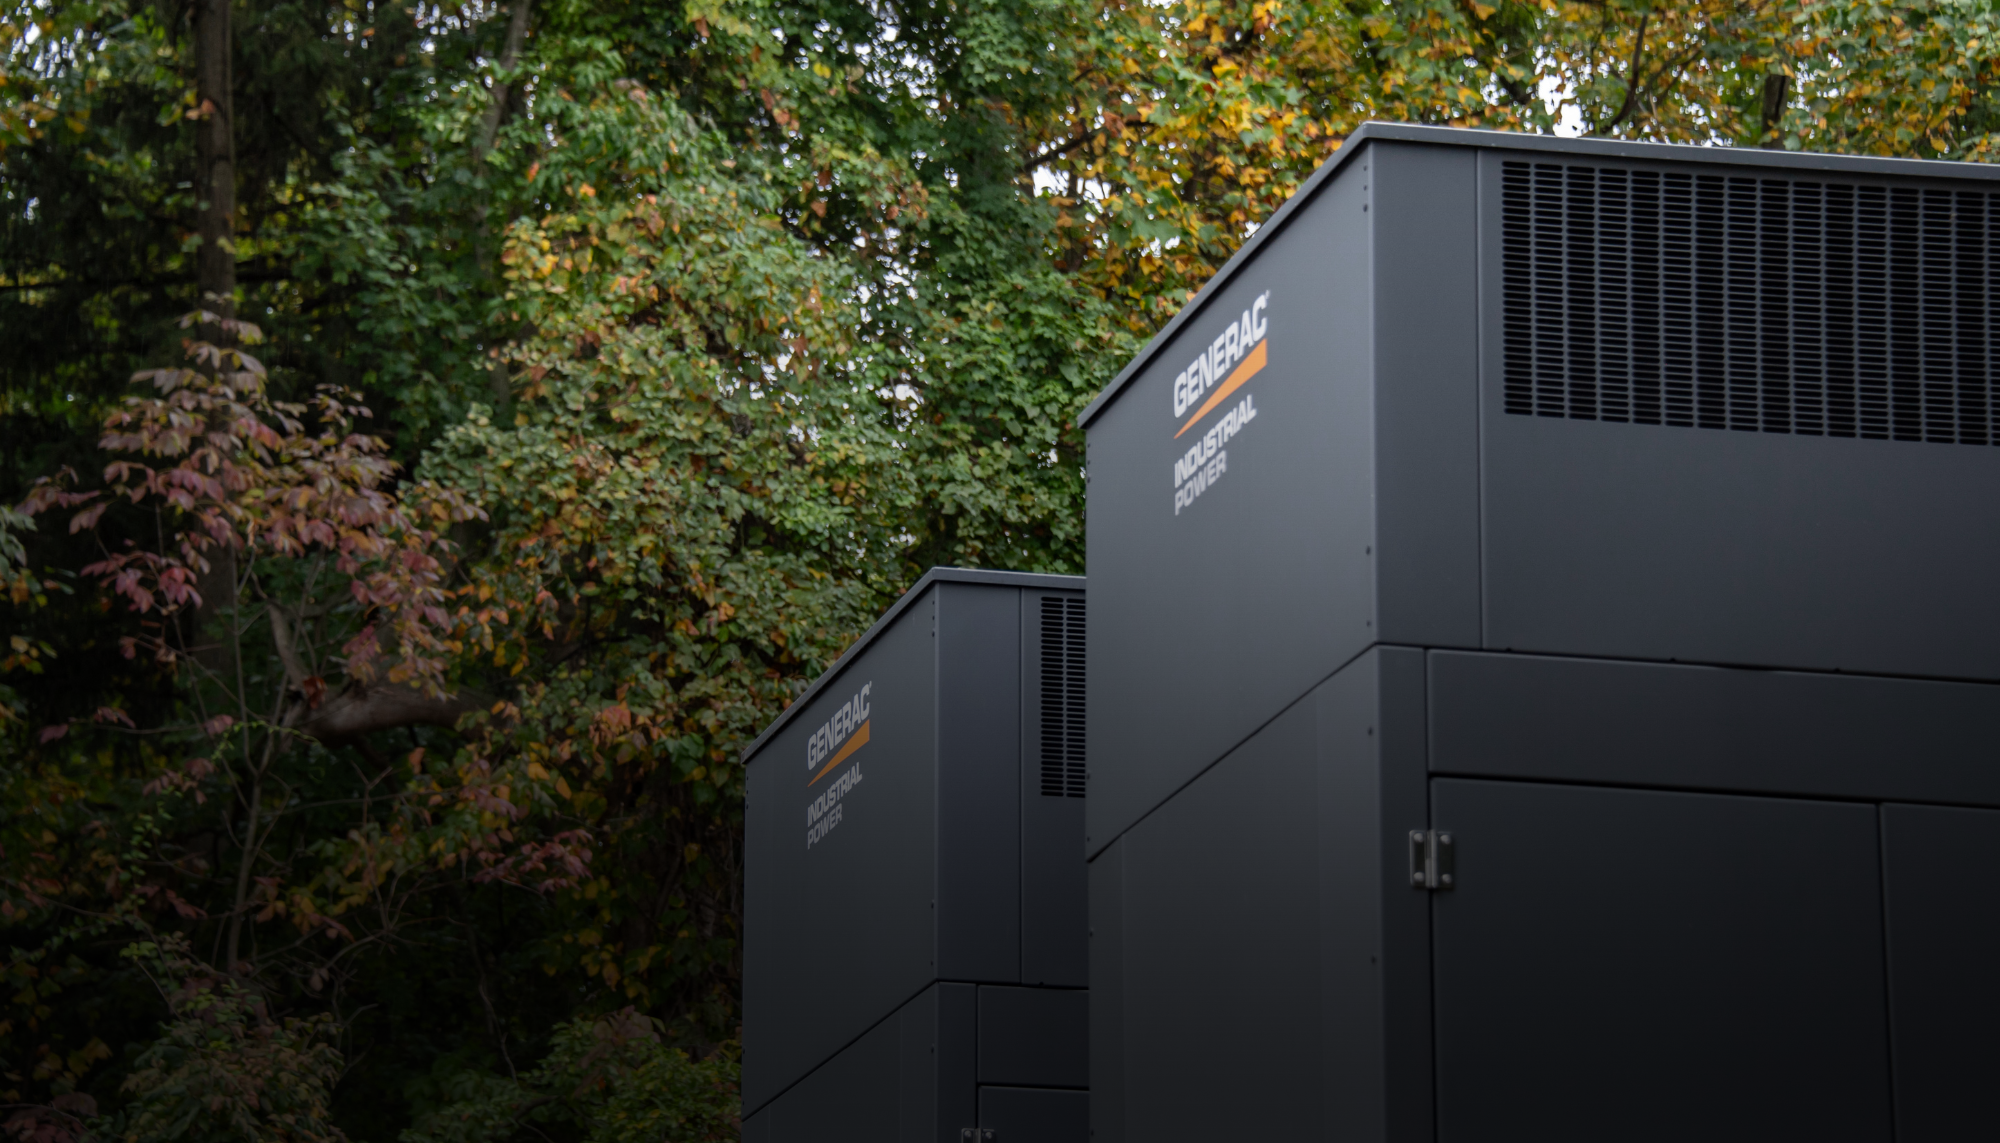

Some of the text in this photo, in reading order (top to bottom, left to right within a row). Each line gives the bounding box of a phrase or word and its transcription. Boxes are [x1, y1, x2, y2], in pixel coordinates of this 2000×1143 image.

[1174, 294, 1268, 418] GENERAC
[1175, 394, 1257, 488] INDUSTRIAL
[1175, 450, 1227, 516] POWER
[807, 683, 870, 770] GENERAC
[807, 762, 863, 827] INDUSTRIAL
[807, 802, 843, 850] POWER
